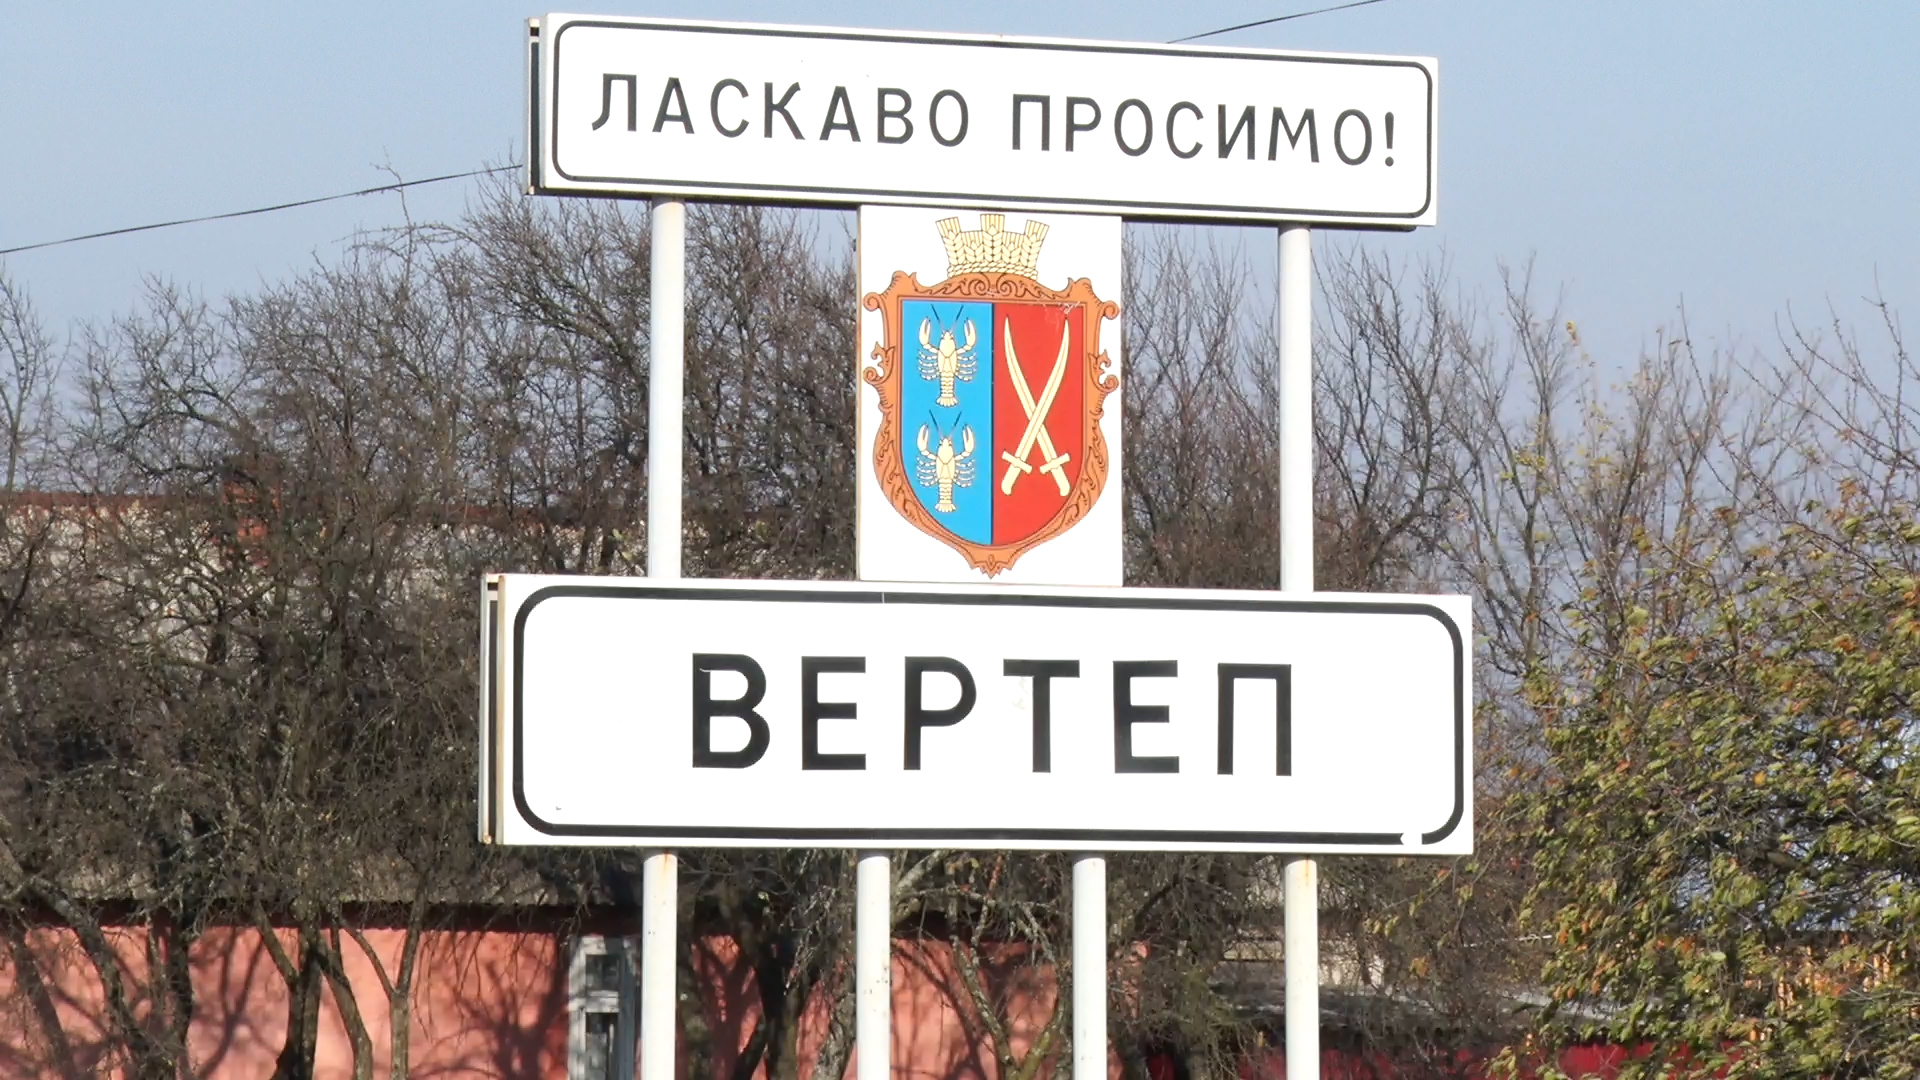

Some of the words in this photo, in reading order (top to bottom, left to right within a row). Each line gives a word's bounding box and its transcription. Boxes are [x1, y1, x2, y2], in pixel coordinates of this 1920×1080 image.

[592, 73, 969, 148] ЛАСКАВО
[1012, 94, 1396, 168] ПРОСИМО!
[691, 653, 1292, 776] ВЕРТЕП
